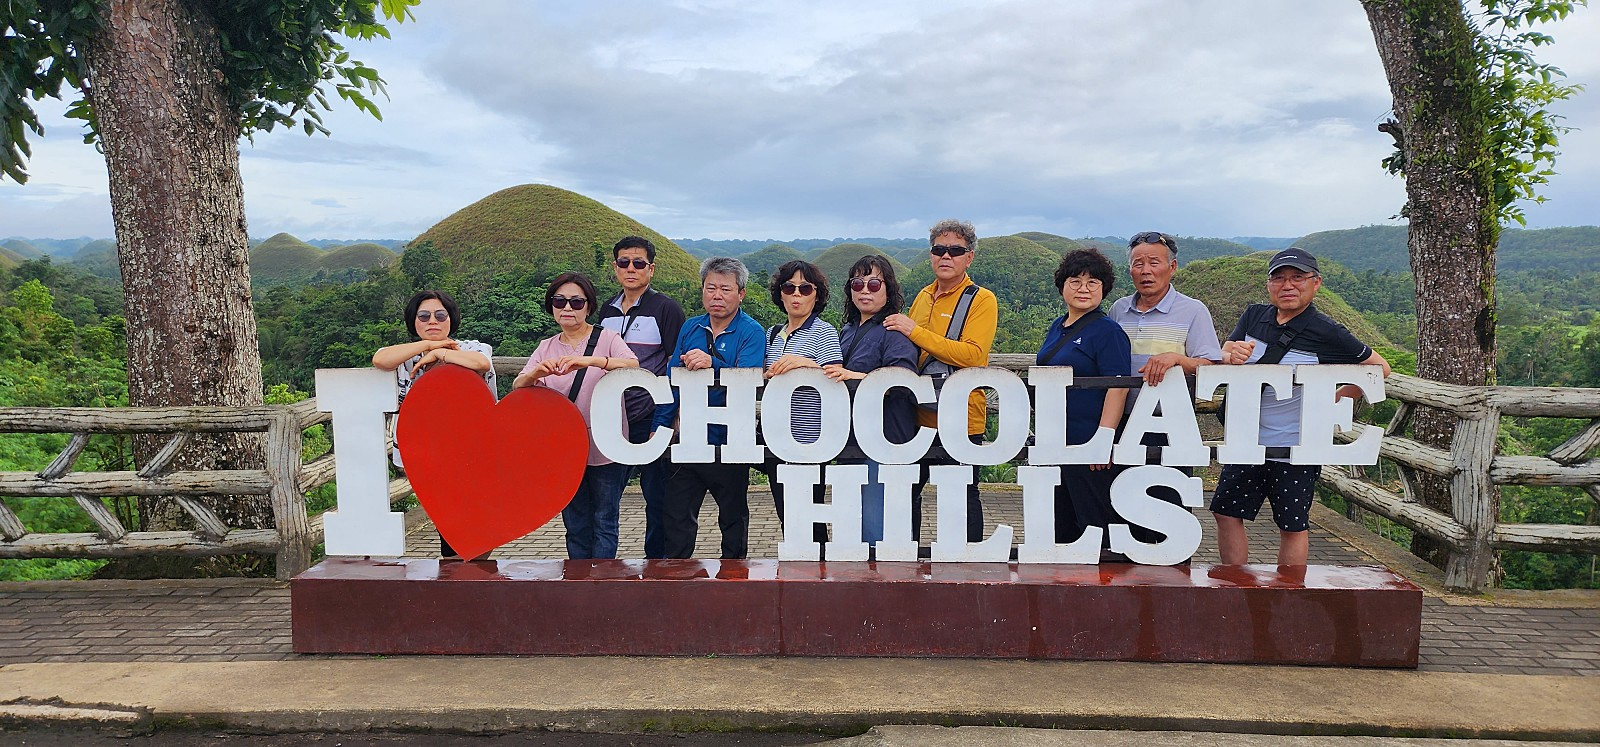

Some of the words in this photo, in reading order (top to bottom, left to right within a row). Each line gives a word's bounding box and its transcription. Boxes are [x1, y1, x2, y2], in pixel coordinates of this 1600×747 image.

[315, 368, 405, 555] I
[590, 364, 1386, 466] CHOCOLATE
[777, 464, 1204, 566] HILLS
